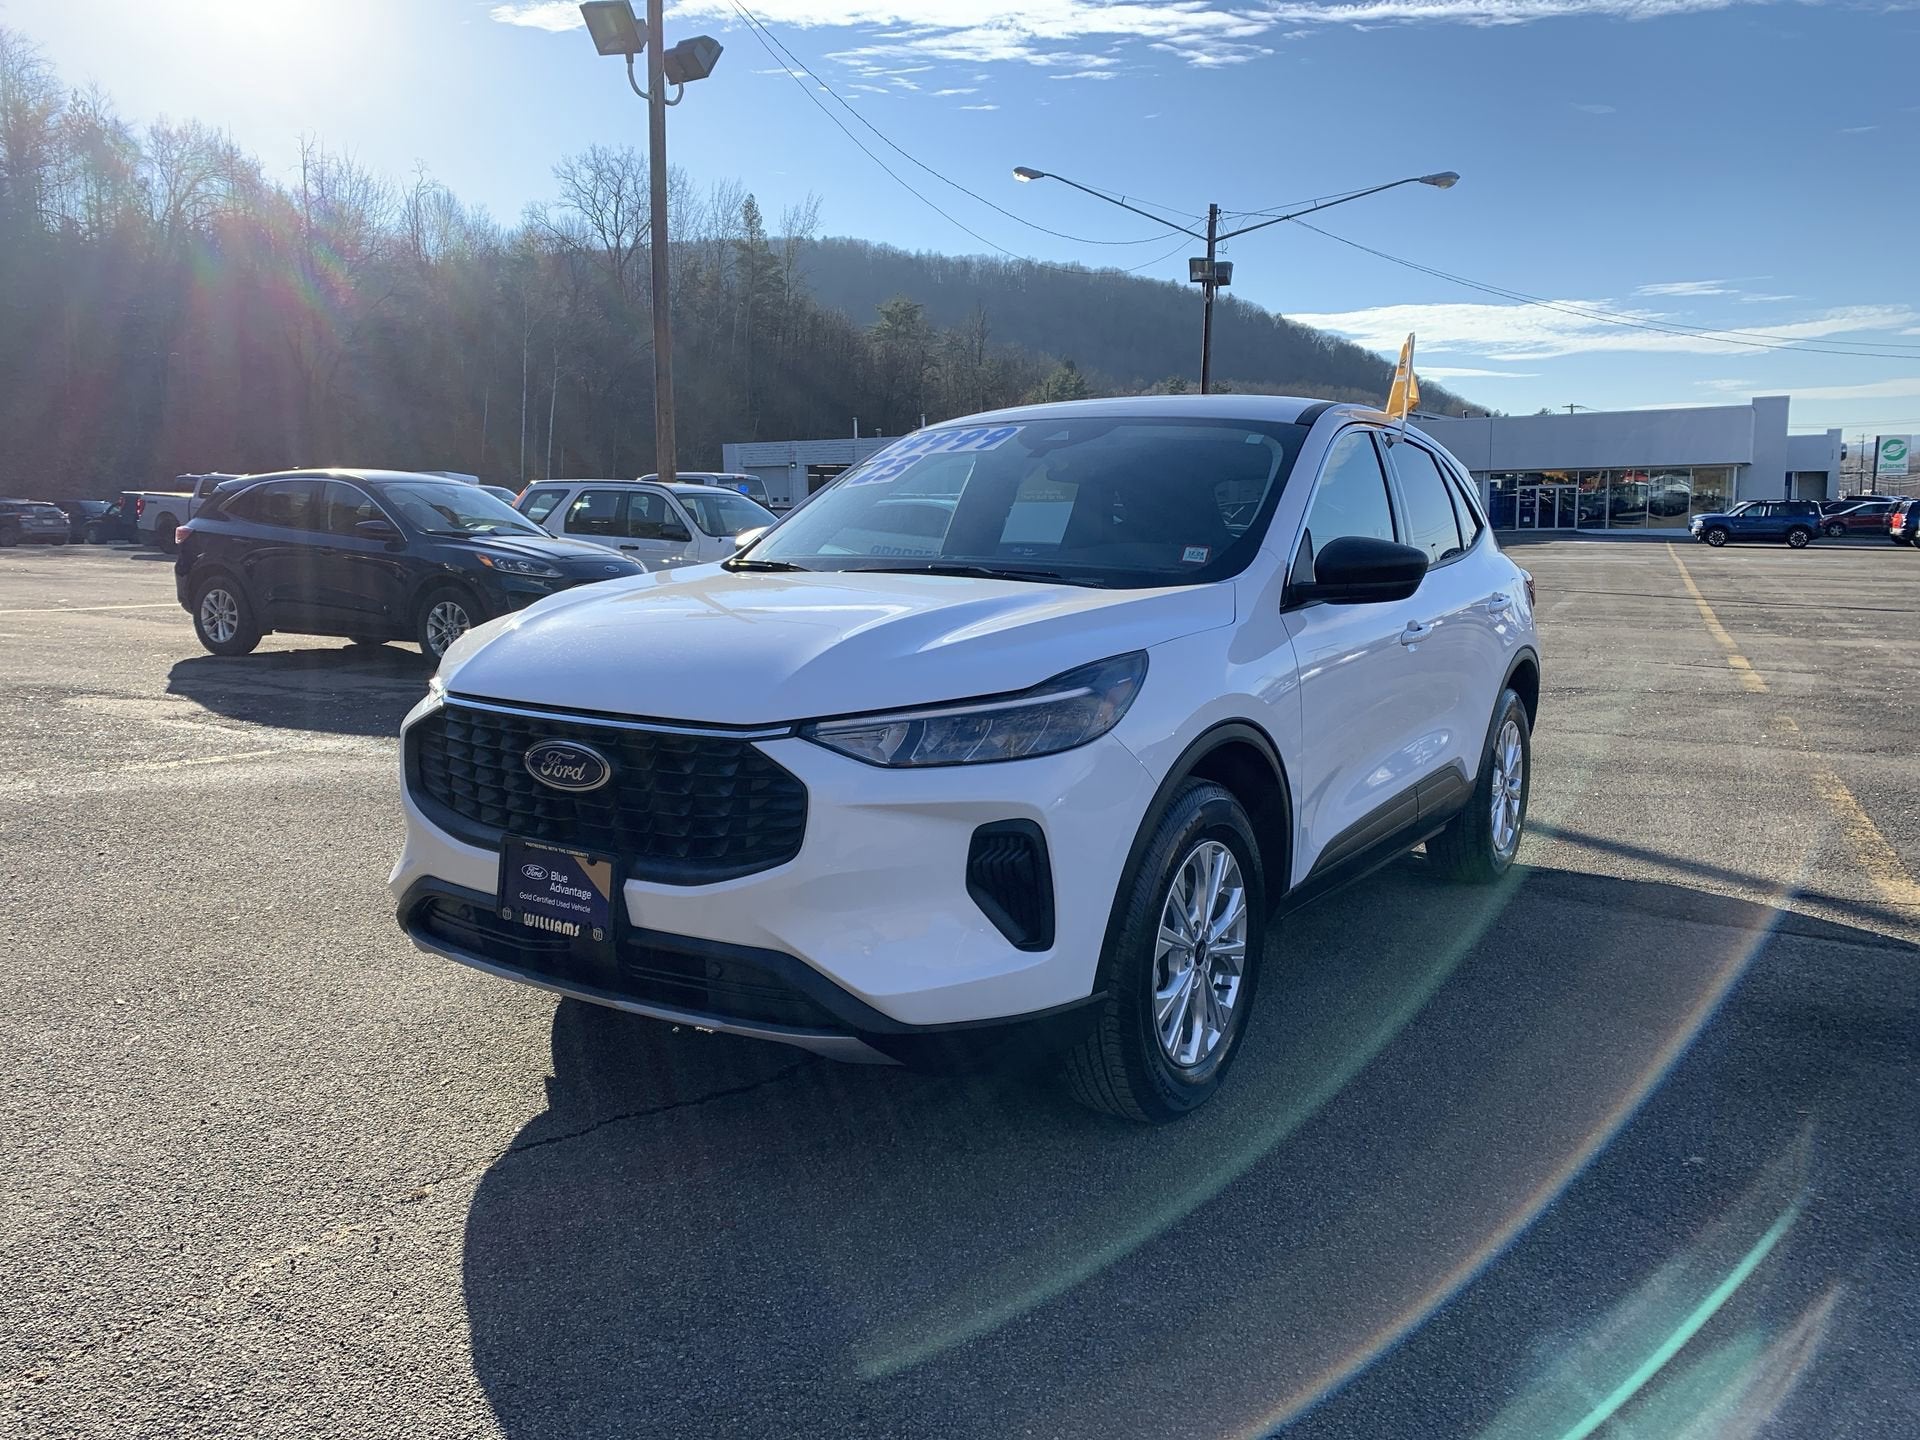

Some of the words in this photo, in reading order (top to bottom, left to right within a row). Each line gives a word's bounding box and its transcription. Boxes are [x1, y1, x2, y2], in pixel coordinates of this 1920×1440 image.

[851, 454, 923, 483] 23
[541, 750, 587, 781] Ford
[525, 865, 544, 878] Ford
[550, 871, 568, 883] Blue
[519, 891, 532, 901] Gold
[532, 894, 556, 906] Certified
[556, 900, 571, 909] Used
[571, 903, 591, 914] Vehicle
[550, 882, 592, 900] Advantage
[523, 912, 580, 937] WILLIAMS
